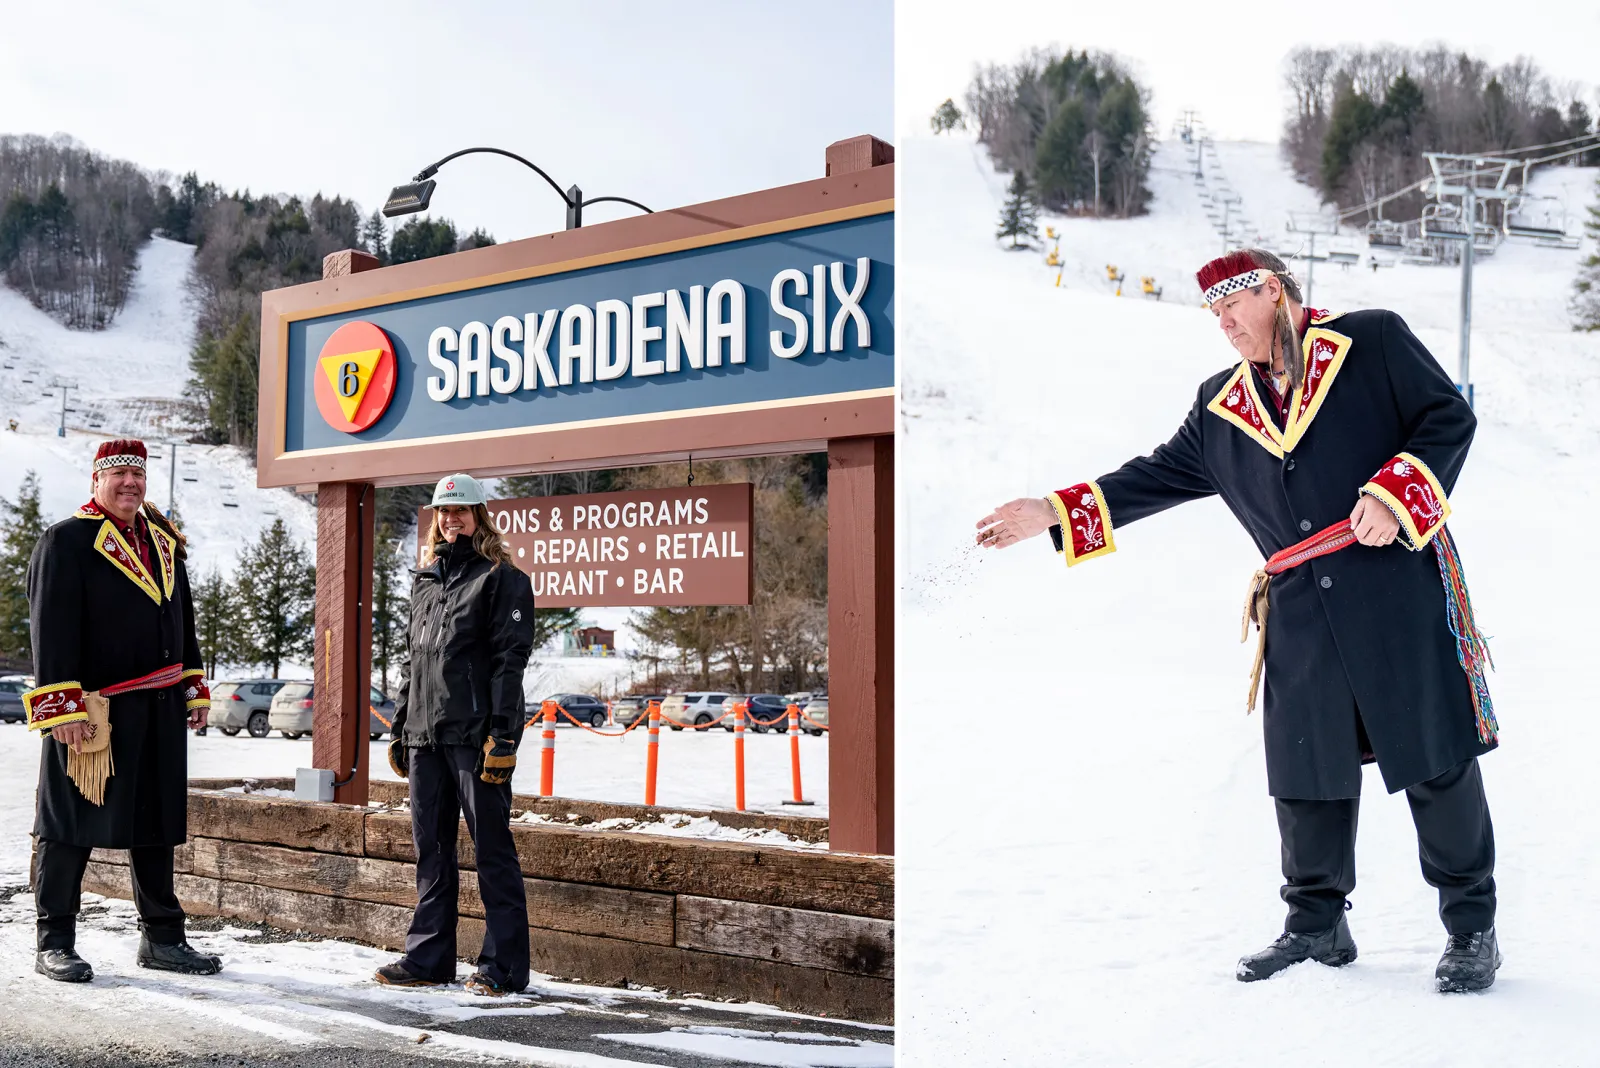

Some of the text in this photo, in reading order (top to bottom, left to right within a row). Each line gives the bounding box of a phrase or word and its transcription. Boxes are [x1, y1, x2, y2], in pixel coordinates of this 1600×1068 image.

[427, 256, 871, 402] SASKADENA SIX
[338, 361, 359, 397] 6
[549, 507, 564, 532] &
[573, 498, 709, 531] PROGRAMS
[533, 536, 629, 565] REPAIRS
[656, 531, 744, 560] RETAIL
[634, 568, 684, 594] BAR
